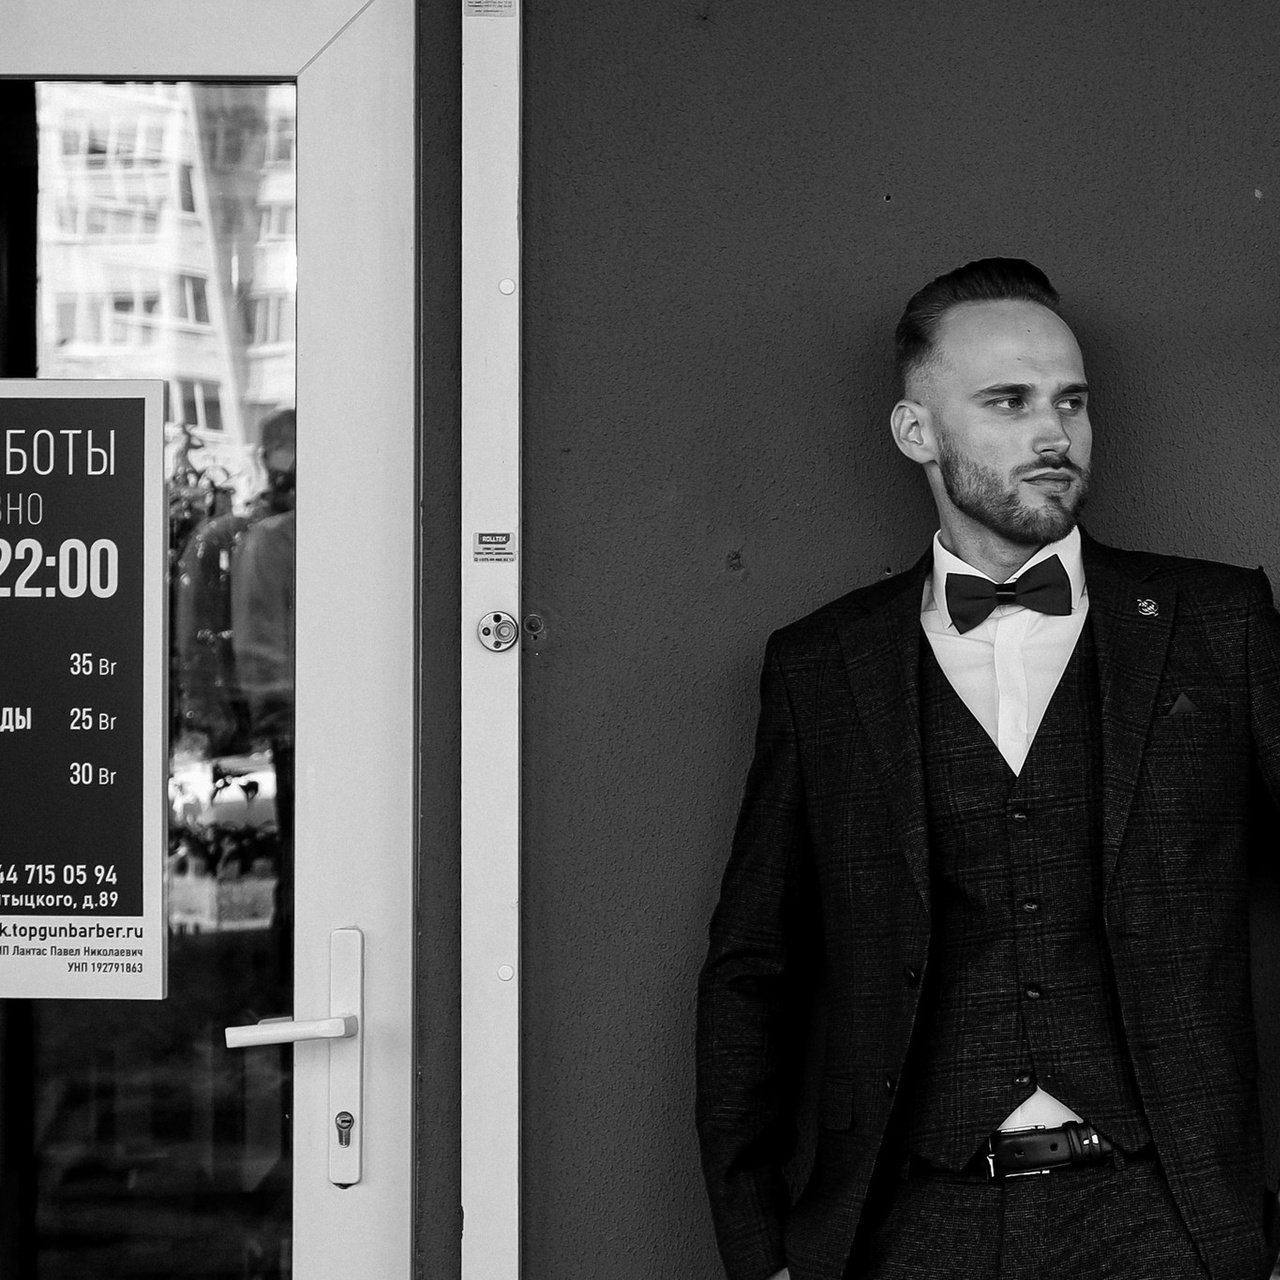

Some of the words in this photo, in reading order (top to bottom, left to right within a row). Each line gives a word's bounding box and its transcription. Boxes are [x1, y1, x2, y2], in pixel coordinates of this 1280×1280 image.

[6, 429, 115, 476] БОТЫ
[0, 492, 43, 526] НО
[70, 652, 93, 676] 35
[99, 658, 117, 676] Br
[70, 707, 93, 730] 25
[99, 713, 117, 731] Br
[70, 762, 93, 785] 30
[99, 767, 117, 786] Br
[25, 864, 56, 885] 715
[63, 864, 87, 885] 05
[94, 864, 118, 885] 94
[0, 894, 77, 909] тыцкого,
[82, 891, 118, 909] д.89
[0, 922, 143, 941] k.topgunbarber.ru
[12, 945, 48, 956] Лантас
[50, 945, 80, 957] Павел
[83, 946, 143, 957] Николаевич
[67, 962, 88, 972] УНП
[91, 962, 143, 973] 192791863
